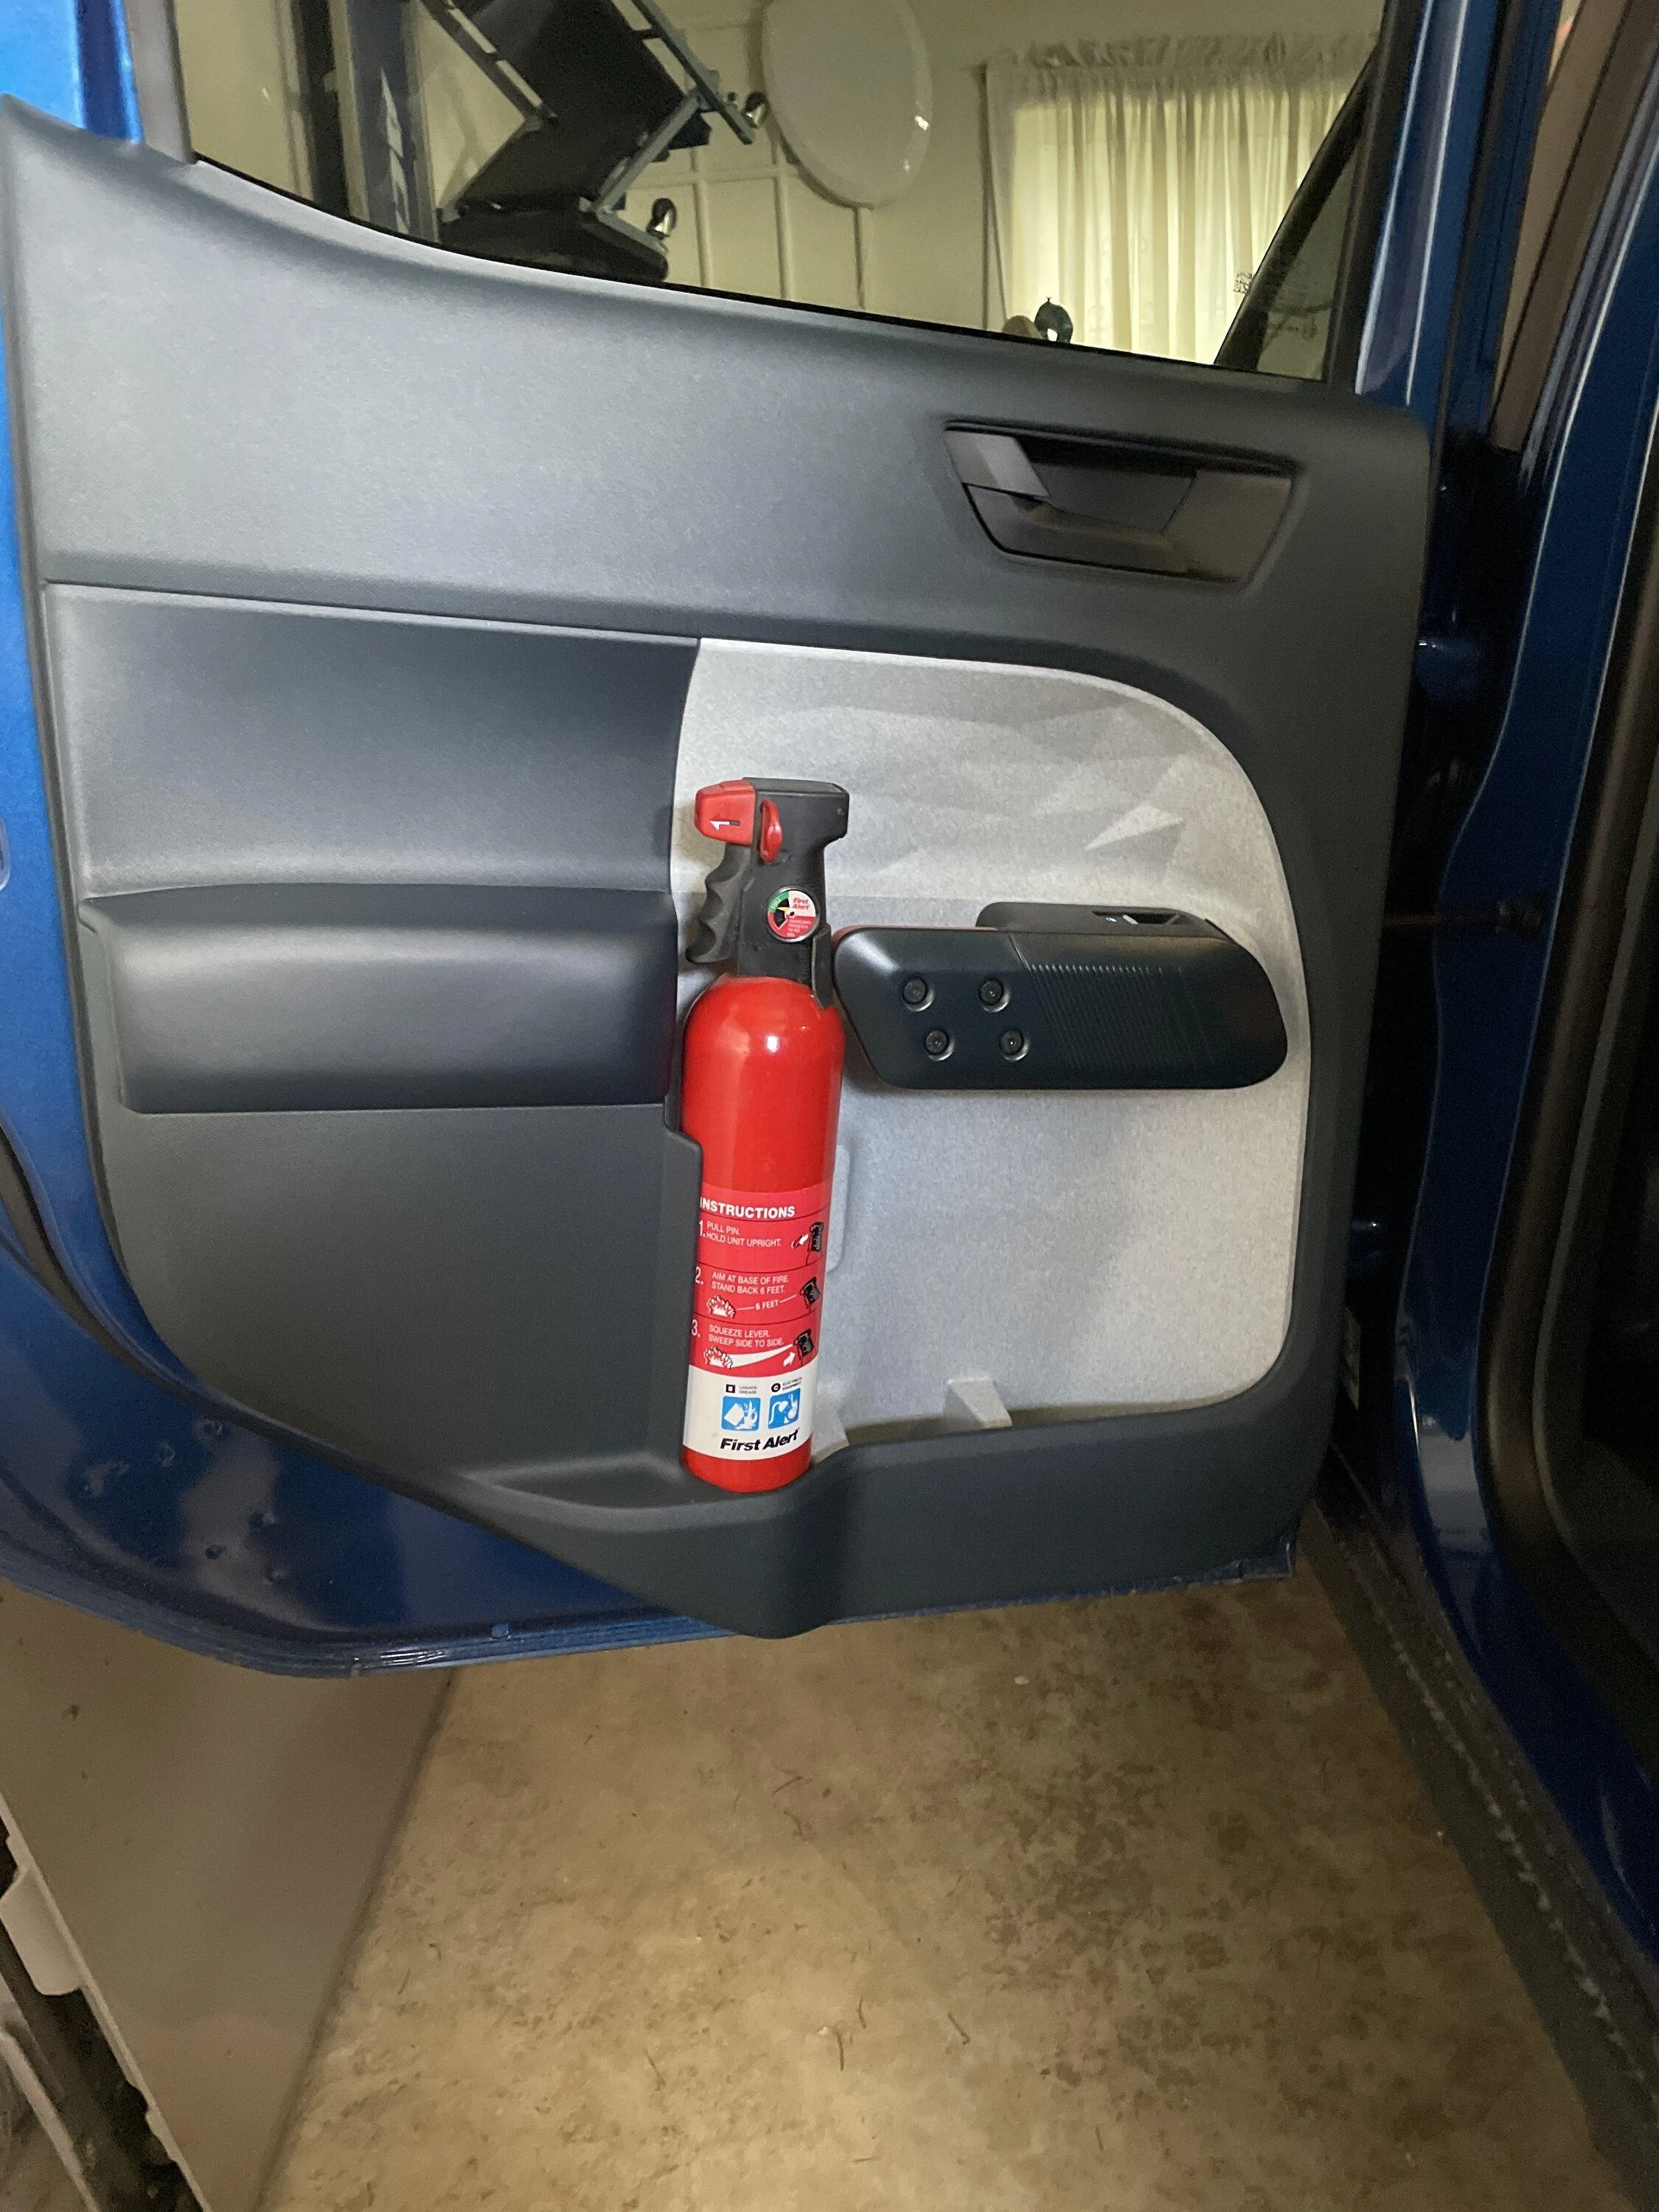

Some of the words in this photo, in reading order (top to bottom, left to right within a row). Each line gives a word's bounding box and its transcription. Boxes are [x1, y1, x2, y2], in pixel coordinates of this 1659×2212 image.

[700, 1197, 796, 1219] INSTRUCTIONS
[707, 1221, 724, 1233] PULL
[726, 1225, 740, 1236] PIN.
[706, 1232, 726, 1243] HOLD
[727, 1237, 745, 1246] UNIT
[746, 1239, 782, 1248] UPRIGHT.
[695, 1266, 703, 1284] 2.
[712, 1271, 726, 1281] AIM
[727, 1274, 737, 1283] AT
[738, 1276, 759, 1284] BASE
[760, 1276, 771, 1284] OF
[772, 1275, 789, 1284] FIRE.
[712, 1281, 735, 1293] STAND
[737, 1286, 758, 1295] BACK
[759, 1287, 765, 1295] 6
[755, 1302, 760, 1310] 6
[762, 1299, 779, 1310] FEET
[692, 1319, 700, 1338] 3.
[709, 1324, 742, 1337] SQUEEZE
[709, 1334, 734, 1346] SWEEP
[735, 1339, 753, 1348] SIDE
[720, 1438, 760, 1451] First
[762, 1429, 799, 1450] Alert
